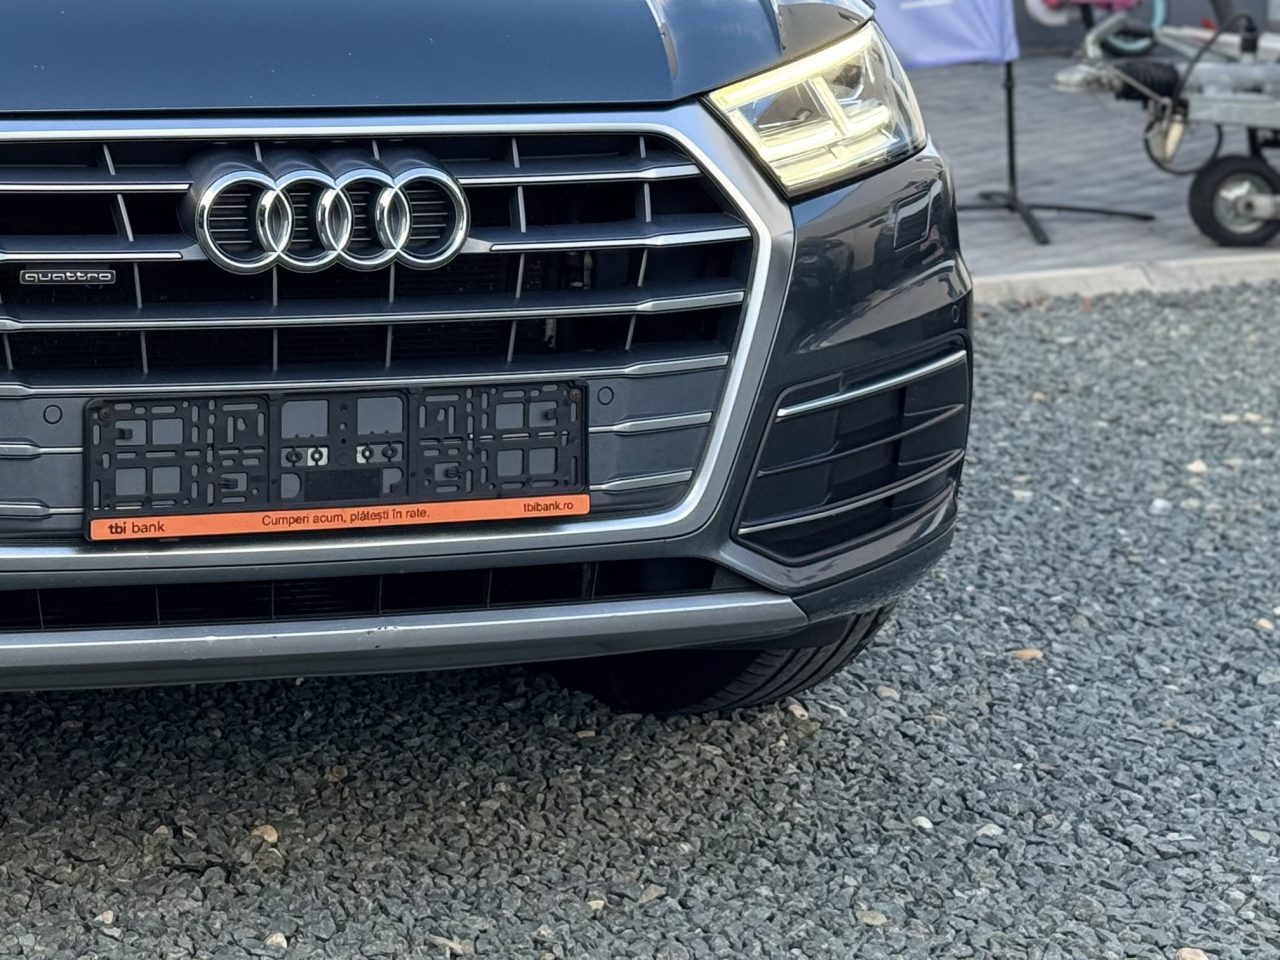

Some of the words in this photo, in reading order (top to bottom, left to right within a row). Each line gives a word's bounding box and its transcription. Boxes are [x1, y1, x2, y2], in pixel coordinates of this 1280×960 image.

[25, 272, 111, 283] quattro
[523, 501, 574, 513] tbibank.ro
[261, 515, 309, 527] Cumperi
[313, 514, 346, 524] acum,
[406, 507, 430, 518] rate.
[108, 522, 127, 535] tbi
[131, 521, 165, 534] bank
